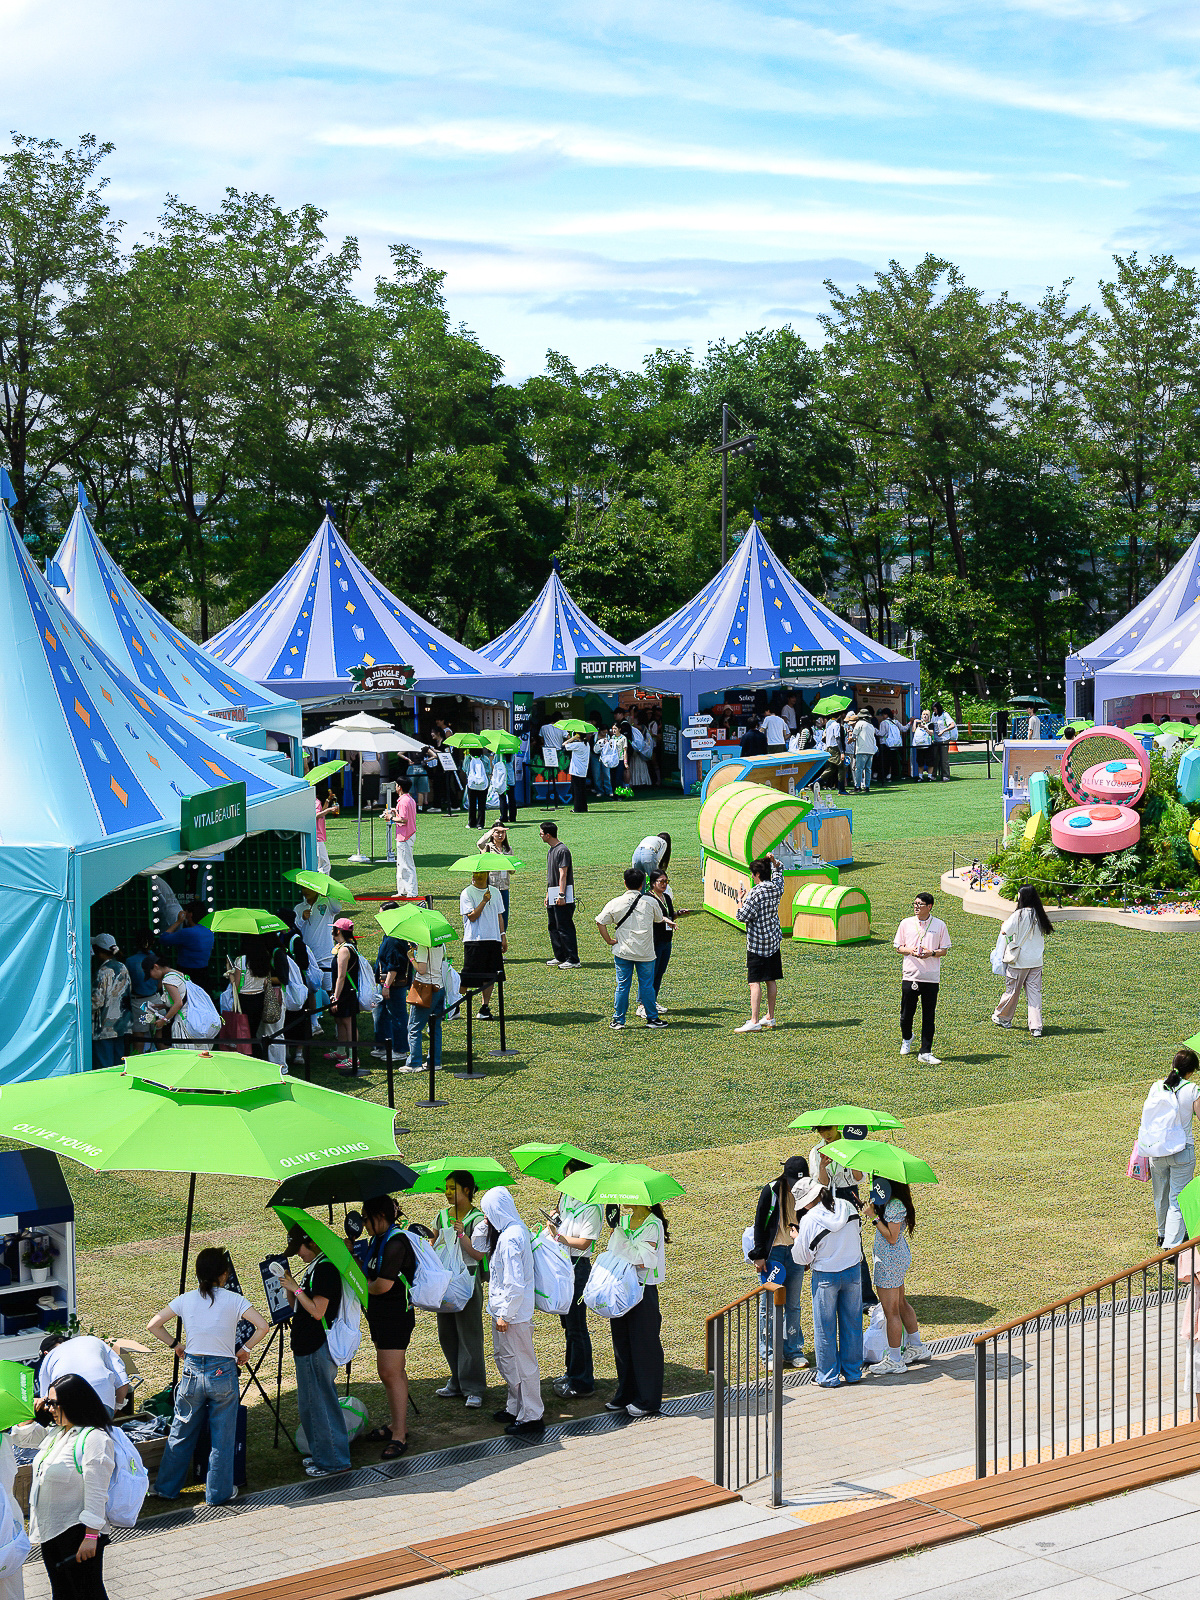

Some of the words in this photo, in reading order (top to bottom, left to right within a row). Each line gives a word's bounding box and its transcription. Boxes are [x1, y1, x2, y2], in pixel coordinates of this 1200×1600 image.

[581, 661, 608, 674] ROOT
[609, 660, 637, 673] FARM
[785, 656, 810, 668] ROOT
[811, 654, 836, 666] FARM
[372, 669, 400, 679] JUNGLE
[1081, 777, 1104, 786] OLIVE
[1105, 779, 1133, 788] YOUNG
[193, 803, 241, 829] VITALBEAUTIE
[713, 878, 727, 896] OLIVE
[847, 1126, 863, 1136] Pulio
[12, 1123, 57, 1141] OLIVE
[55, 1135, 103, 1158] YOUNG
[279, 1151, 319, 1170] OLIVE
[318, 1141, 370, 1161] YOUNG
[874, 1183, 886, 1200] Pulio
